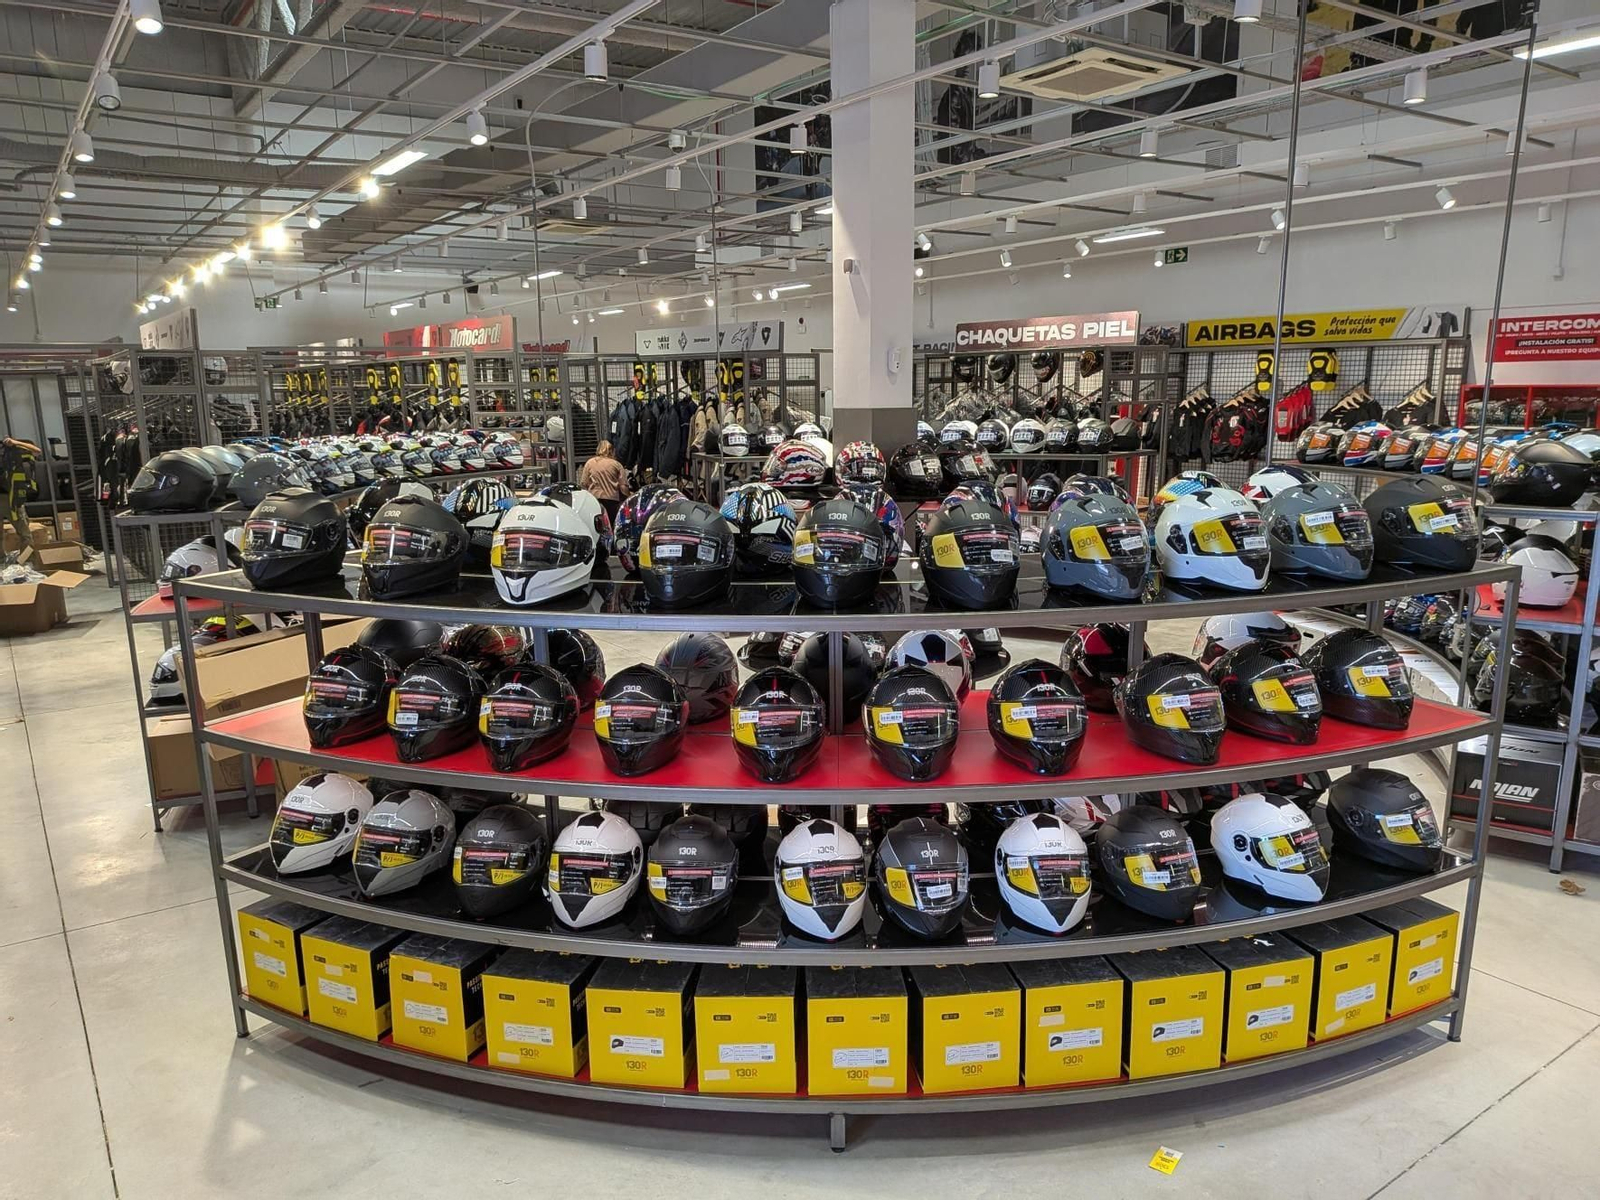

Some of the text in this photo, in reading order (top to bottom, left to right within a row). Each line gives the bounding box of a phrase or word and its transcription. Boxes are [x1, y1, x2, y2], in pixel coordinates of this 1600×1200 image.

[1330, 316, 1397, 327] Protección que
[956, 320, 1136, 346] CHAQUETAS PIEL
[1194, 319, 1316, 342] AIRBAGS
[1323, 325, 1373, 336] salva vidas
[667, 513, 687, 522] 130R
[828, 512, 848, 522] 130R
[970, 512, 991, 522] 130R
[1201, 528, 1223, 543] 130R
[1076, 535, 1099, 550] 130R
[936, 543, 955, 557] 130R
[477, 829, 496, 839] 130R
[679, 846, 697, 855] 130R
[891, 879, 907, 890] 130R
[1259, 1031, 1279, 1041] 130R
[519, 1047, 540, 1058] 130R
[1166, 1046, 1186, 1056] 130R
[626, 1060, 647, 1070] 130R
[1063, 1055, 1084, 1065] 130R
[736, 1068, 758, 1078] 130R
[847, 1069, 869, 1079] 130R
[961, 1065, 983, 1075] 130R
